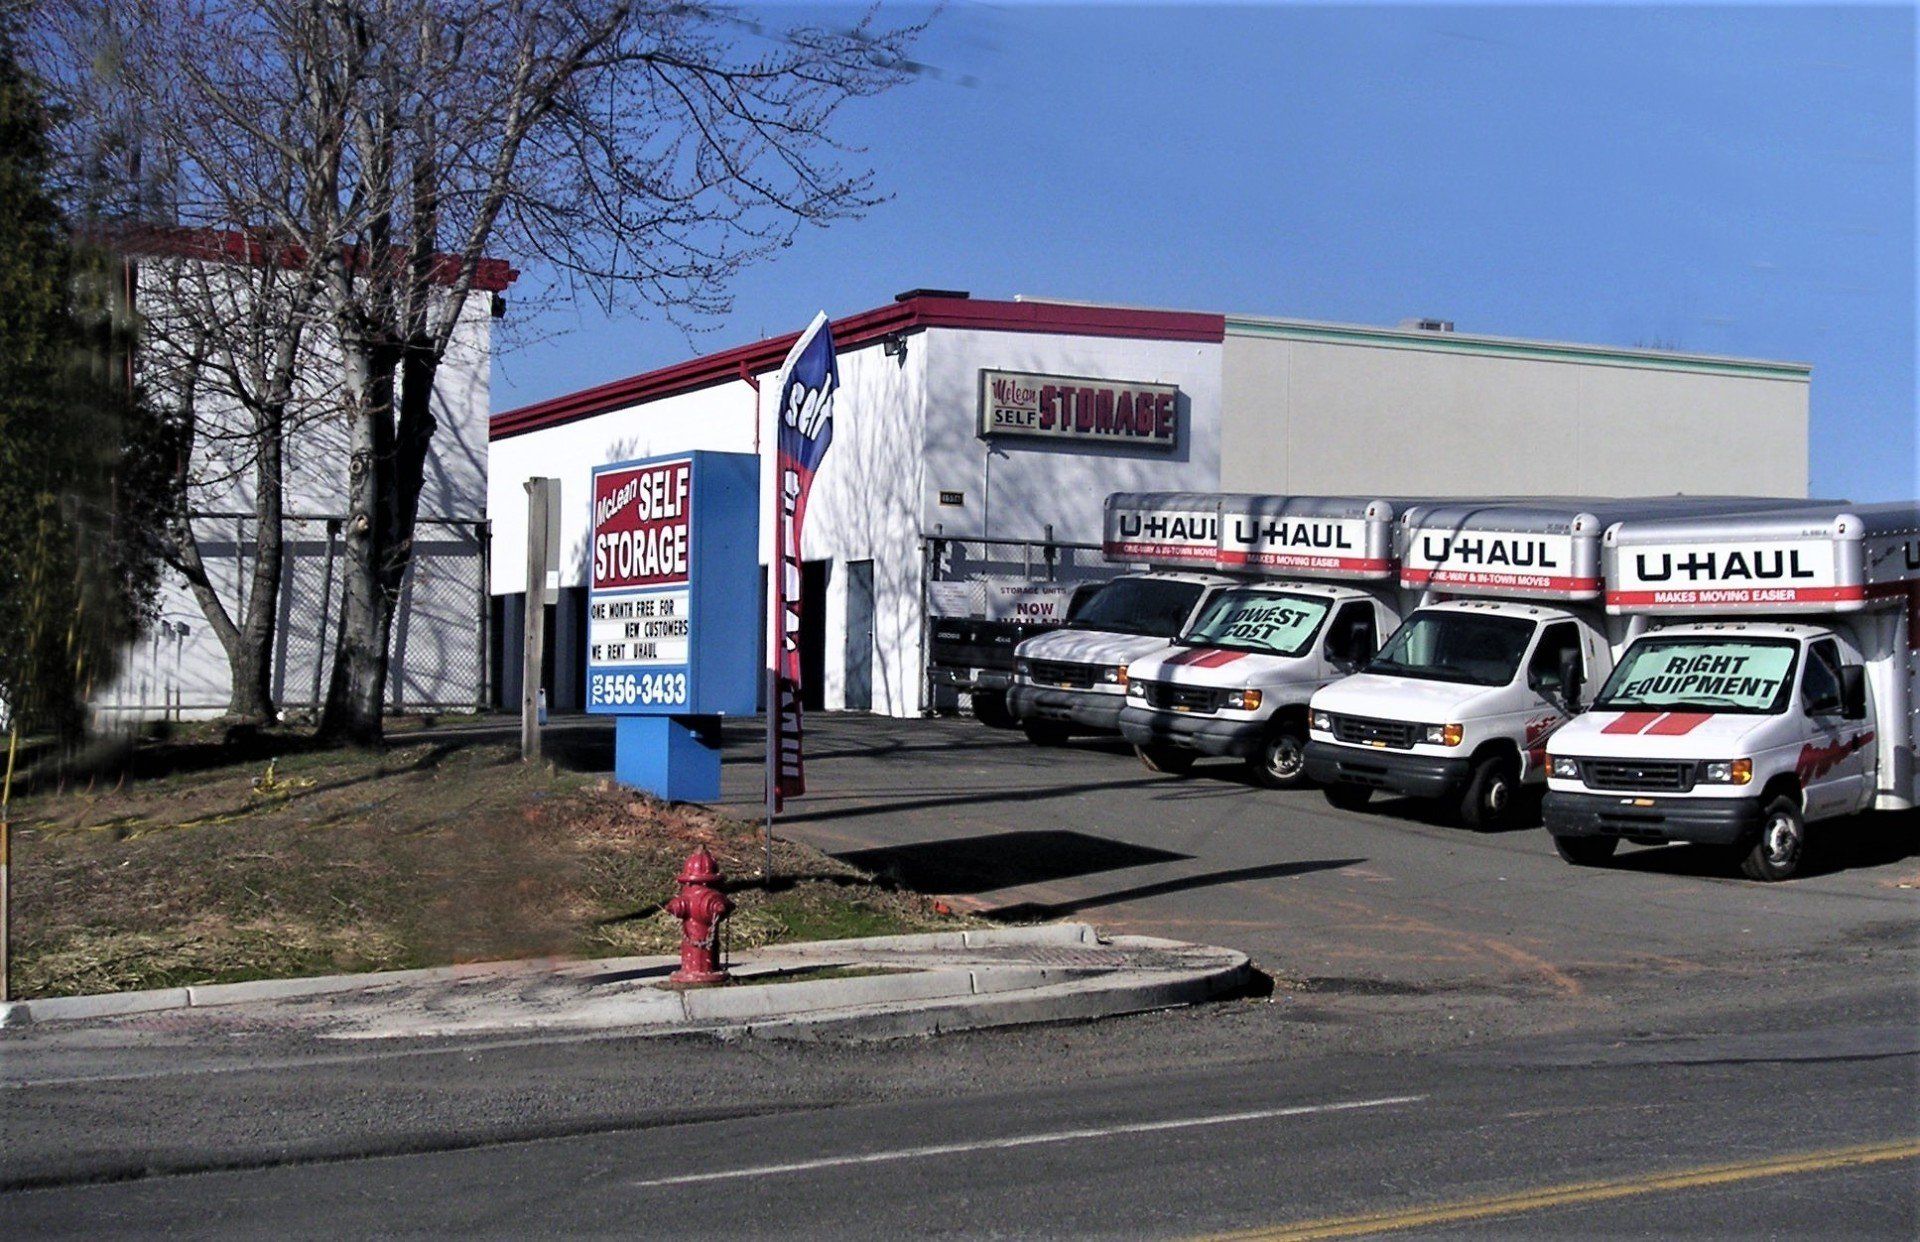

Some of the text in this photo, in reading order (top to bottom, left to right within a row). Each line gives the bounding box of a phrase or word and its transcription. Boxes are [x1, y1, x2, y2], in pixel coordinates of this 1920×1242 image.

[995, 410, 1036, 425] SELF
[1039, 385, 1174, 438] STORAGE
[596, 467, 688, 528] McLean SELF
[1120, 515, 1217, 540] U-HAUL
[1236, 520, 1351, 549] U-HAUL
[595, 524, 687, 581] STORAGE
[1247, 554, 1340, 568] MAKES MOVING EASIER
[1424, 537, 1556, 568] U-HAUL
[1636, 549, 1814, 581] U-HAUL
[1430, 571, 1550, 587] ONE-WAY & IN-TOWN MOVES
[1001, 586, 1067, 595] STORAGE UNITS
[1655, 589, 1796, 603] MAKES MOVING EASIER
[592, 599, 674, 619] ONE MONTH FREE FOR
[1017, 602, 1054, 615] NOW
[1220, 606, 1310, 628] LOWEST
[625, 619, 688, 638] NEW CUSTOMERS
[1220, 623, 1280, 639] COST
[592, 642, 657, 660] WE RENT UHAUL
[1665, 654, 1749, 674] RIGHT
[592, 673, 686, 705] 703 556-3433
[1622, 675, 1780, 698] EQUIPMENT
